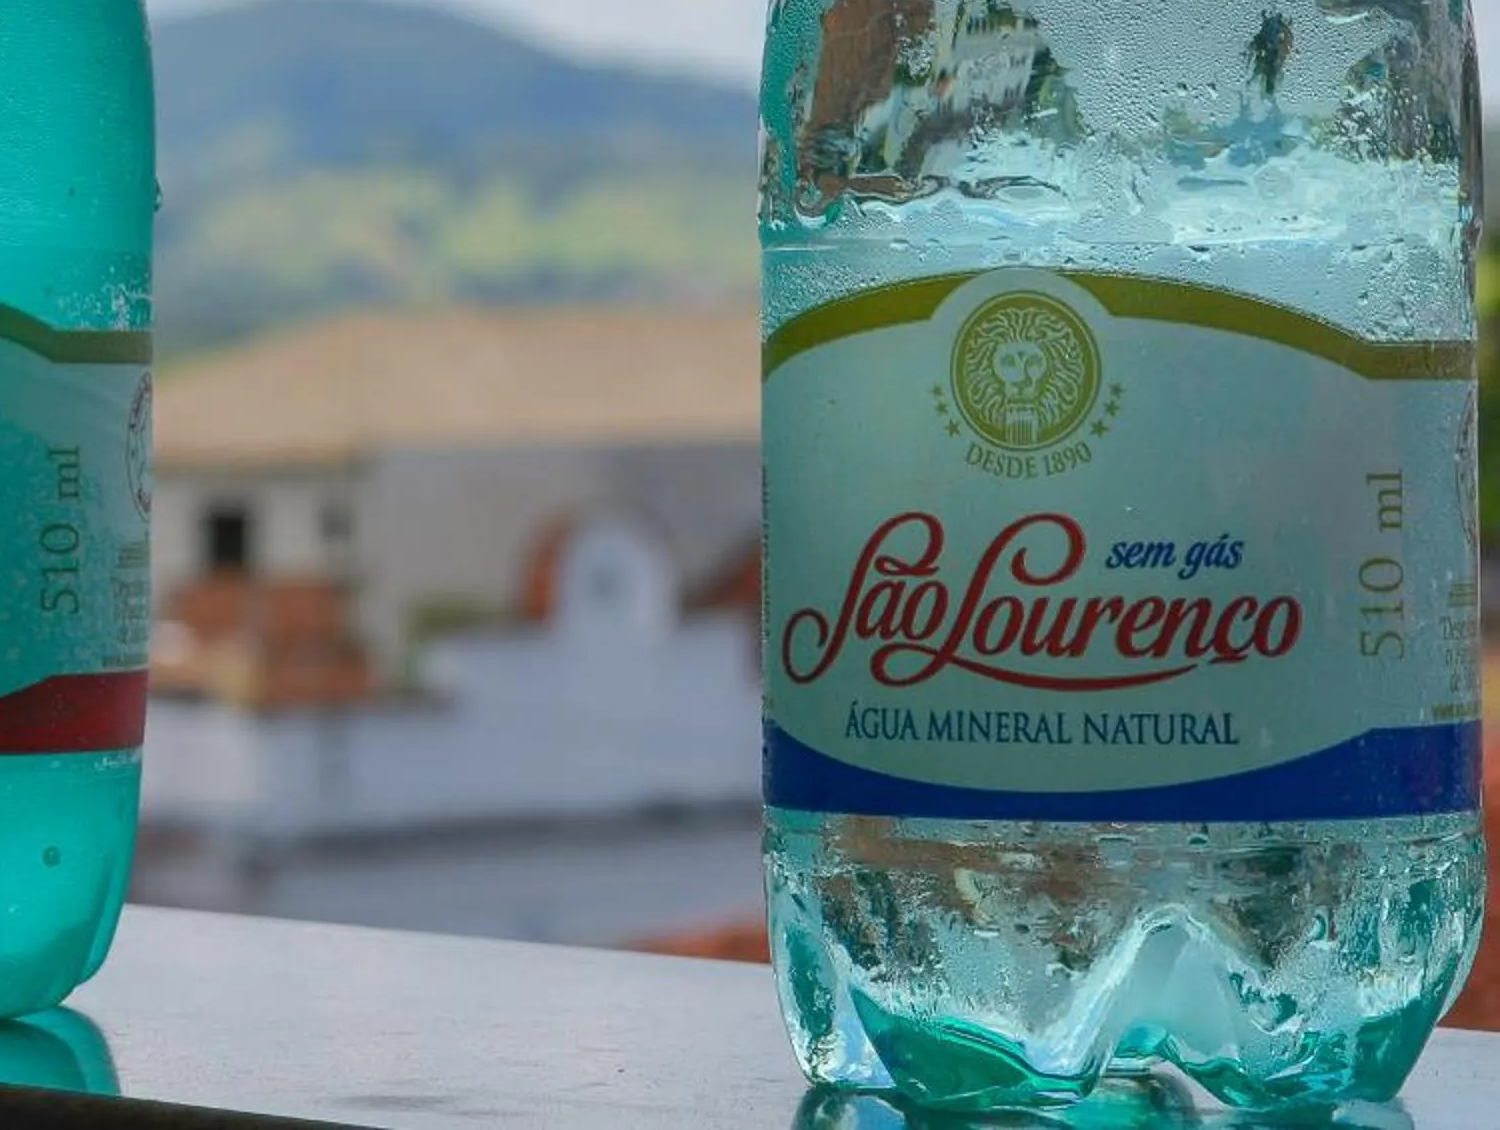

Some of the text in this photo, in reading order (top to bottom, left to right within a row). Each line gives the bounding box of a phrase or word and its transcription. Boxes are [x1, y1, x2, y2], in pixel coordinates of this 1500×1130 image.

[964, 440, 1092, 479] DESDE 1890
[40, 446, 80, 614] 510 ml
[1105, 532, 1245, 579] sem gás
[1358, 469, 1404, 660] 510 ml
[782, 511, 948, 685] São
[870, 513, 1303, 693] Lourenço
[844, 701, 1240, 746] ÁGUA MINERAL NATURAL
